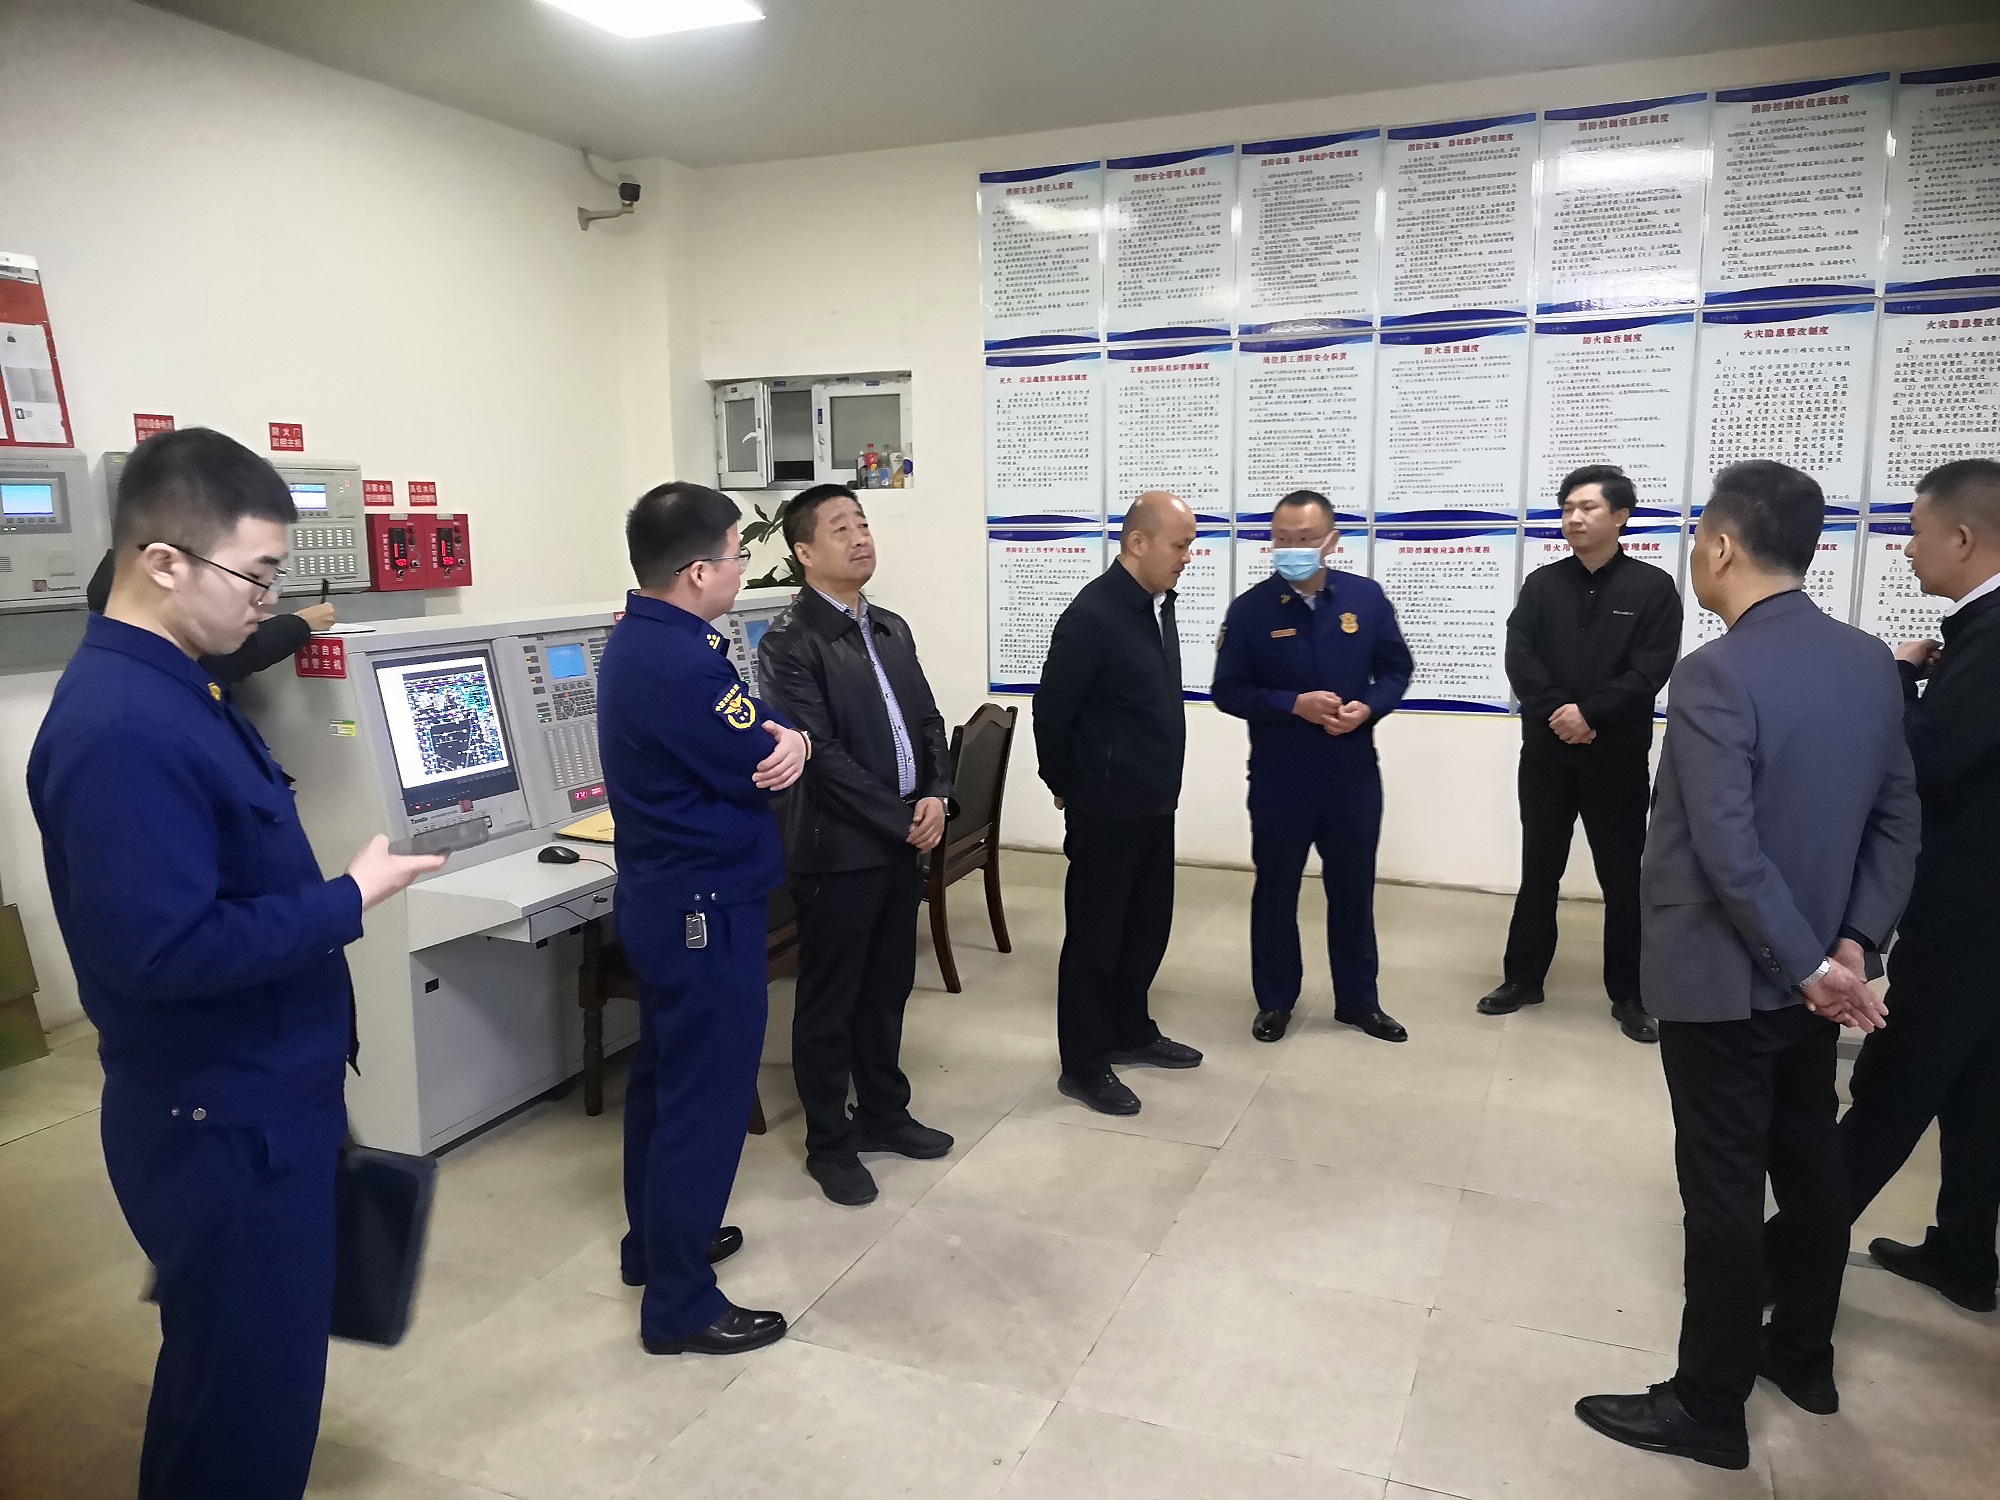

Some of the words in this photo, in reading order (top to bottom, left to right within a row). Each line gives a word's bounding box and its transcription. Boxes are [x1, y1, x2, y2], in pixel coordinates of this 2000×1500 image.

[1751, 94, 1850, 115] 消防控制室值班制度
[1578, 113, 1670, 132] 消防控制室值班制度
[1133, 166, 1206, 183] 消防安全管理人职责
[1005, 181, 1074, 196] 消防安全责任人职责
[1743, 325, 1829, 340] 火灾隐患整改制度
[1583, 333, 1643, 345] 防火检查制度
[1424, 344, 1480, 355] 防火巡查制度
[1262, 352, 1347, 365] 岗位员工消防安全职责
[271, 426, 301, 437] 防火门
[272, 437, 303, 448] 监控主机
[1543, 542, 1661, 552] 用火用管理制度
[301, 658, 342, 670] 报警主机
